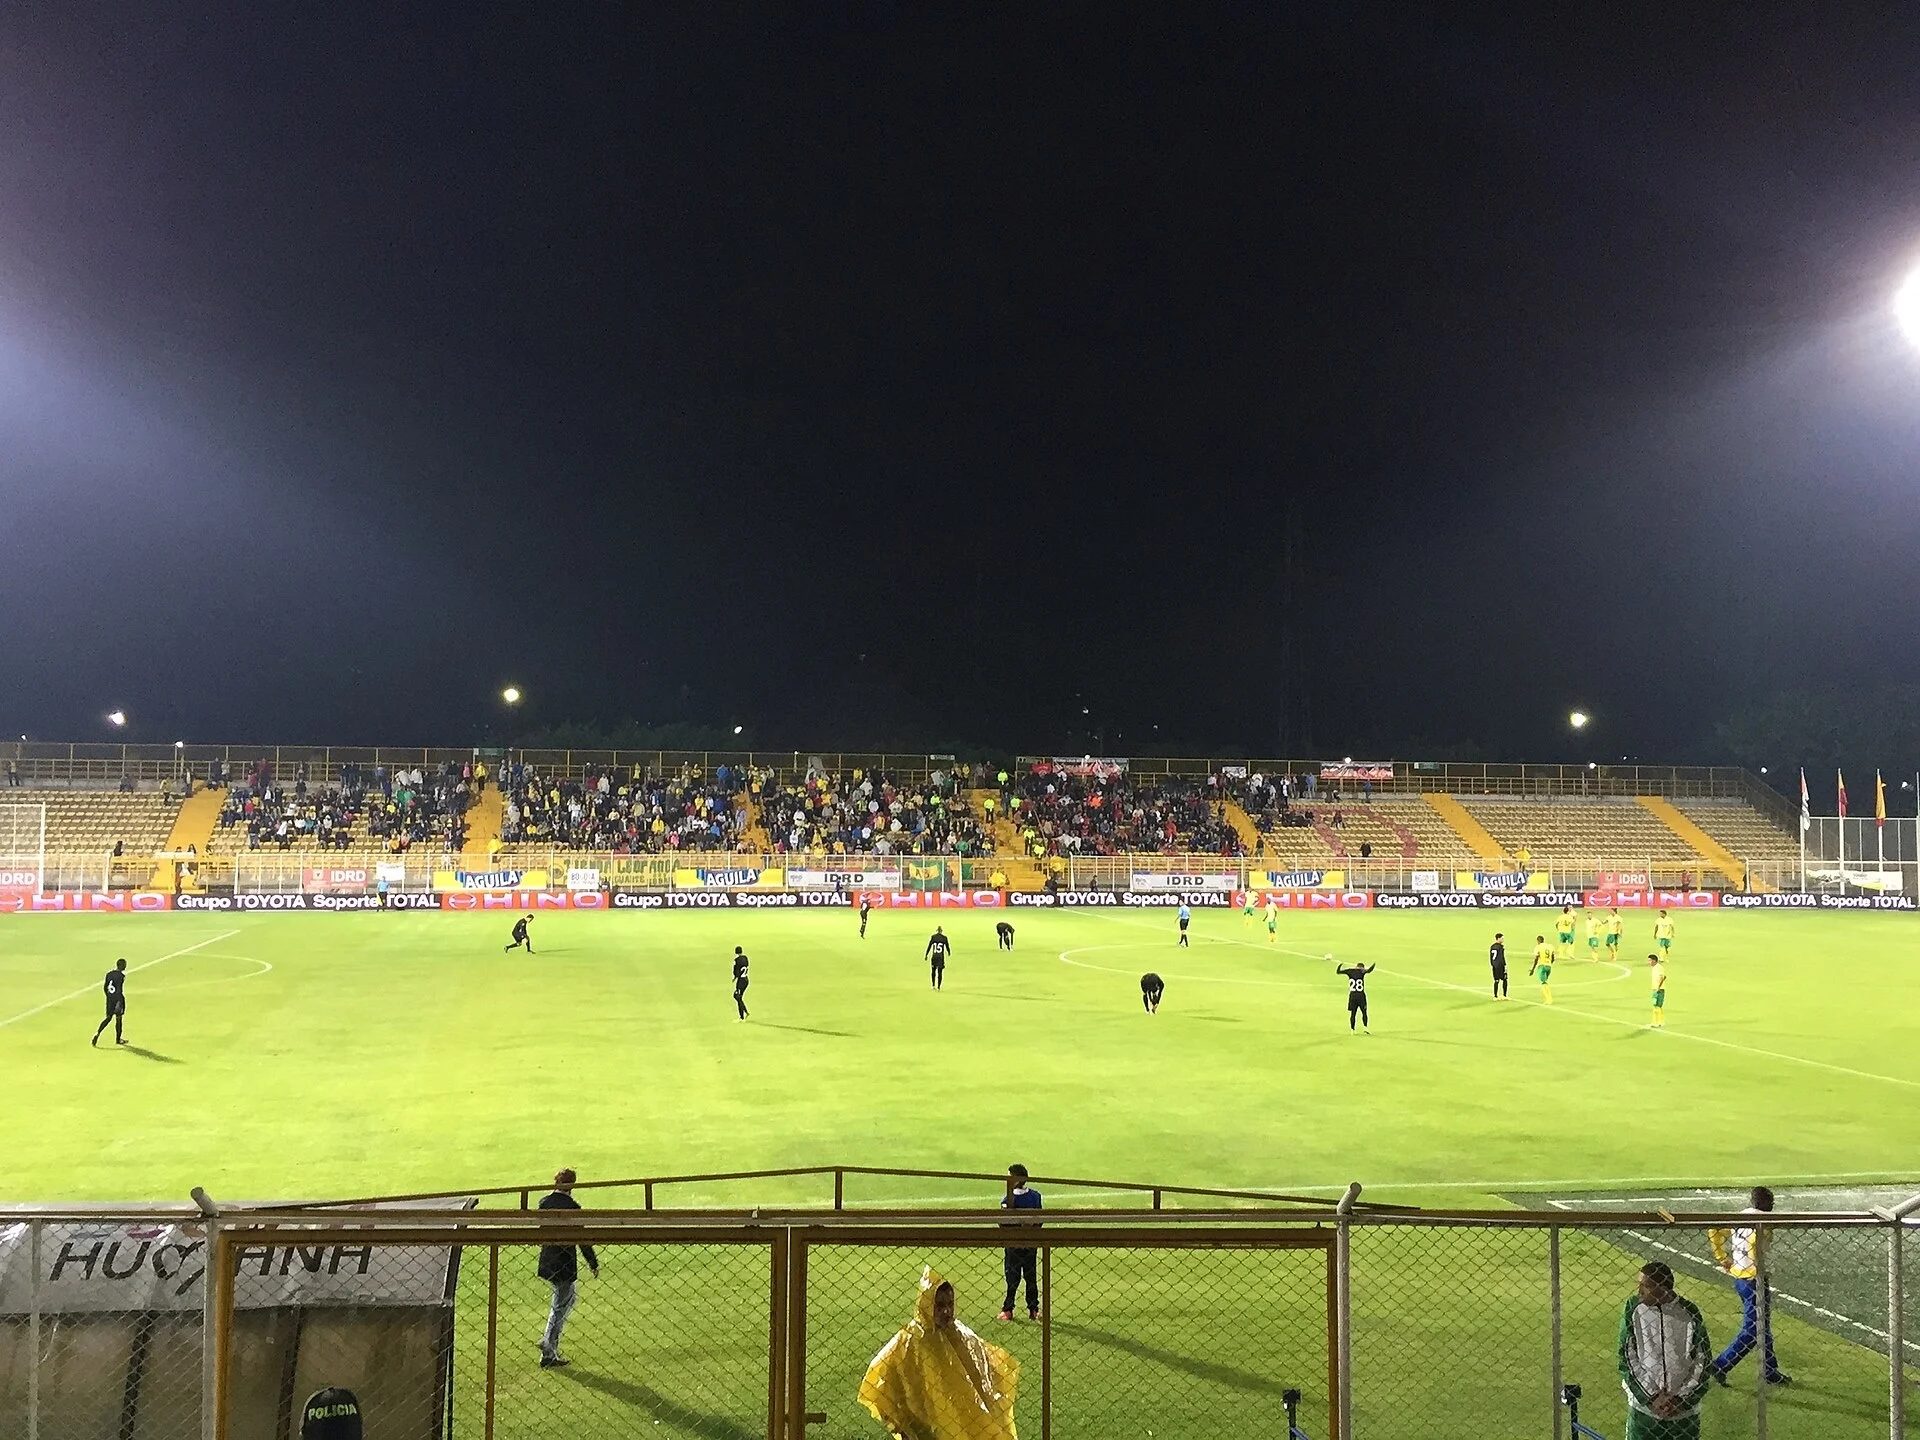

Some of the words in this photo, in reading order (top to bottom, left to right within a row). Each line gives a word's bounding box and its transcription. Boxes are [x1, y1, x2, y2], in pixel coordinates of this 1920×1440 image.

[0, 873, 35, 885] DRD
[330, 870, 366, 882] IDRD
[824, 873, 864, 883] IDRD
[1166, 876, 1205, 885] IDRD
[1618, 873, 1646, 884] IDRD
[32, 893, 164, 910] HINO
[177, 895, 232, 910] Grupo
[234, 894, 306, 908] TOYOTA
[313, 894, 378, 910] Soporte
[386, 894, 440, 908] TOTAL
[484, 893, 604, 909] HINO
[615, 894, 662, 908] Grupo
[665, 893, 730, 906] TOYOTA
[736, 893, 797, 908] Soporte
[800, 892, 851, 905] TOTAL
[891, 891, 1000, 907] HINO
[1011, 893, 1055, 907] Grupo
[1057, 892, 1115, 905] TOYOTA
[1123, 892, 1179, 907] Soporte
[1181, 892, 1229, 905] TOTAL
[1266, 893, 1368, 908] HINO
[1377, 893, 1419, 908] Grupo
[1420, 893, 1478, 906] TOYOTA
[1482, 893, 1535, 908] Soporte
[1537, 893, 1583, 905] TOTAL
[1617, 893, 1713, 907] HINO
[1722, 895, 1762, 908] Grupo
[1763, 894, 1817, 906] TOYOTA
[1821, 895, 1871, 908] Soporte
[1871, 896, 1916, 908] TOTAL
[933, 943, 944, 953] 15
[1491, 949, 1498, 960] 7
[107, 980, 116, 993] 6
[1349, 979, 1363, 992] 28
[308, 1404, 357, 1421] POLICIA
